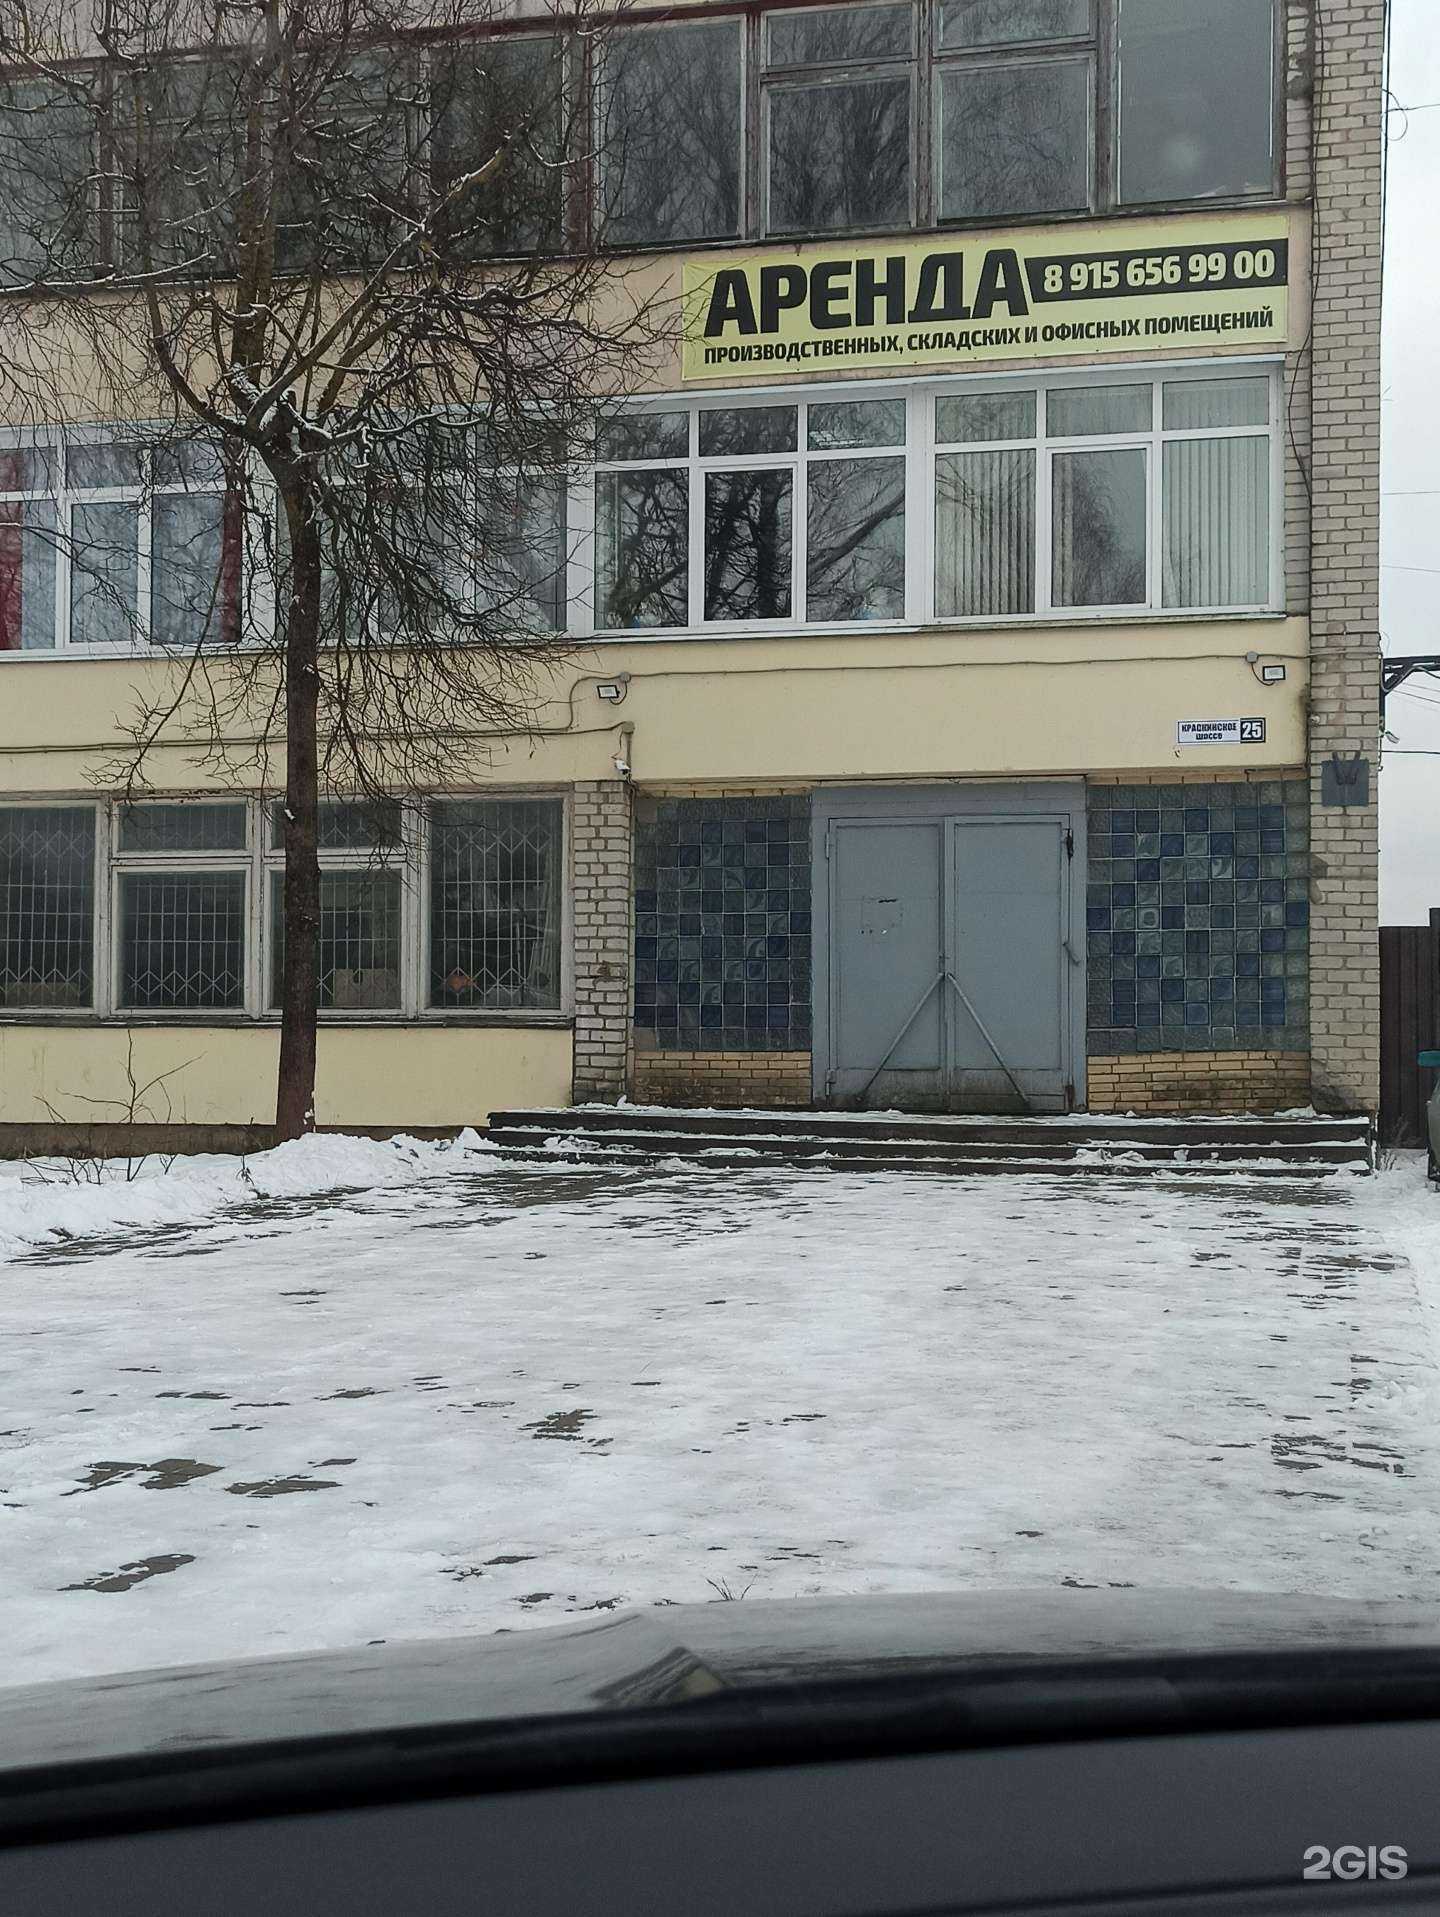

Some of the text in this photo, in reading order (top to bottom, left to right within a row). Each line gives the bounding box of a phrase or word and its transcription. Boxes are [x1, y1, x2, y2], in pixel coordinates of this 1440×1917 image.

[704, 249, 1029, 337] АРЕНДА
[1044, 249, 1275, 293] 8 915 656 99 00
[705, 306, 1274, 364] ПРОИЗВОДСТВЕННЫХ, СКЛАДСКИХ И ОФИСНЫХ ПОМЕЩЕНИЙ
[1242, 722, 1262, 738] 25
